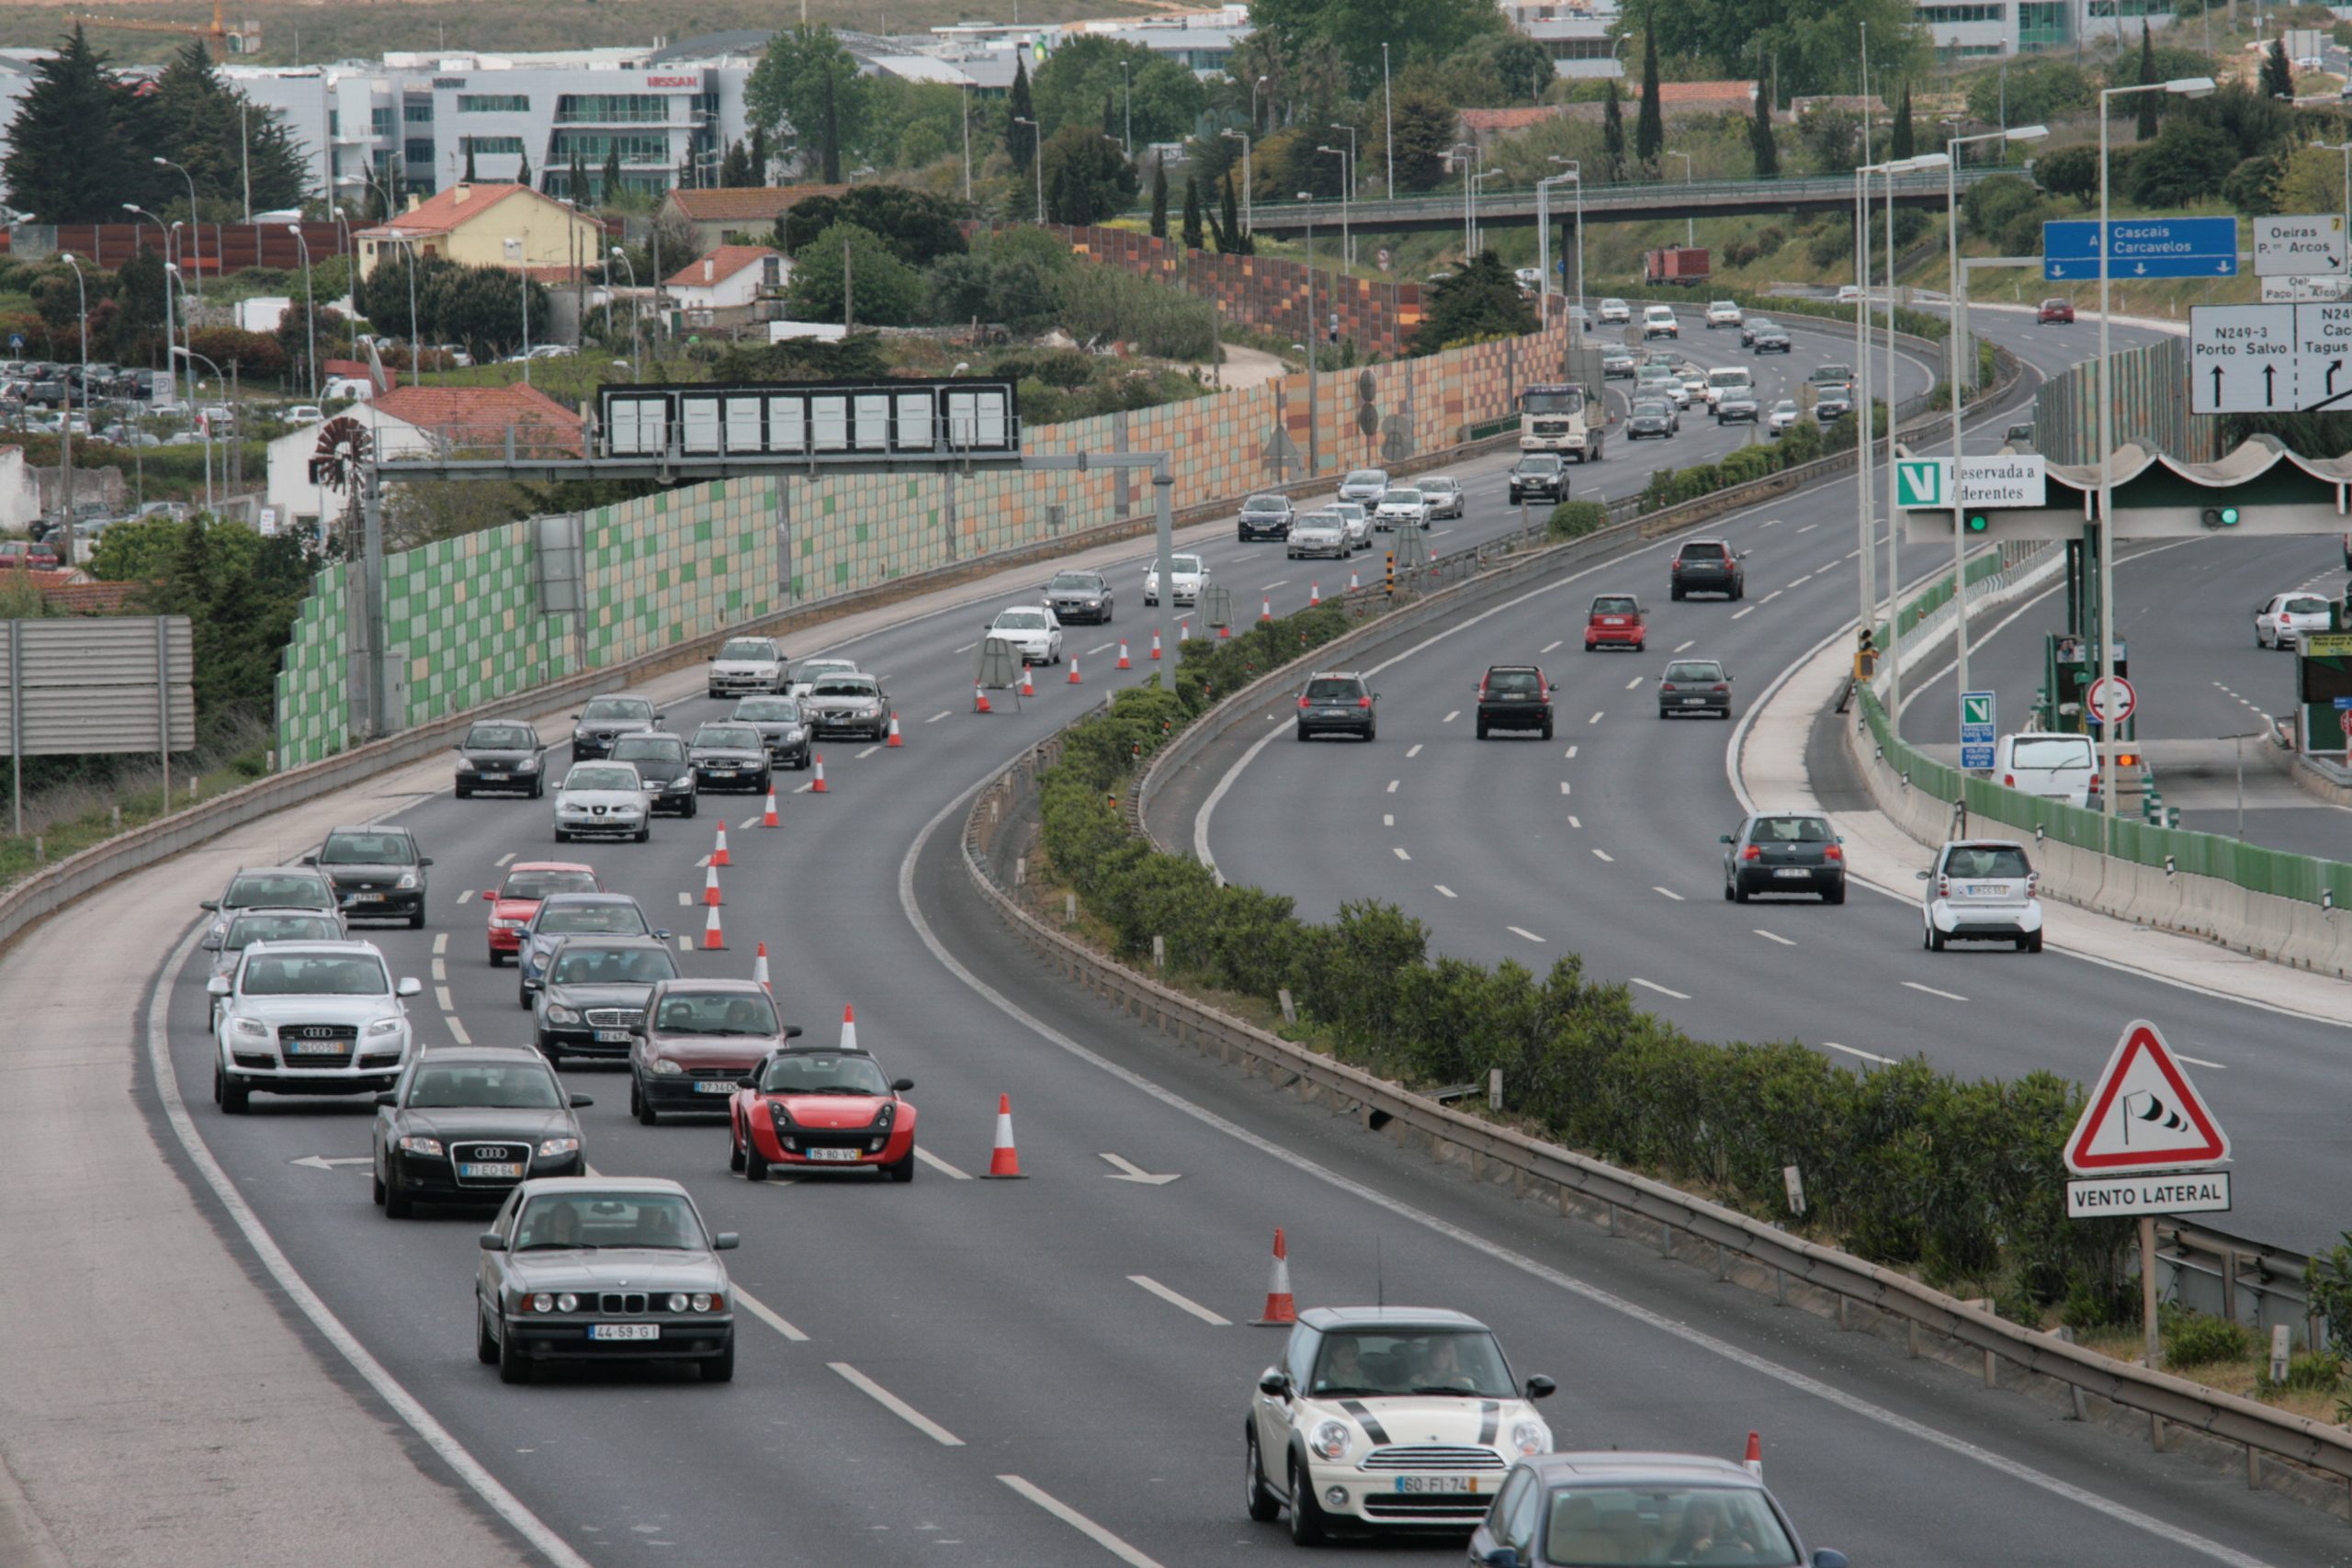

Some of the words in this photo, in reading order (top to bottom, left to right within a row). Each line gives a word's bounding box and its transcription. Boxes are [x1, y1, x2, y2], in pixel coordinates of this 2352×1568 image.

[647, 76, 696, 86] NISSAN
[2333, 219, 2340, 230] 7
[2115, 225, 2169, 238] Cascais
[2271, 227, 2317, 238] Oeiras
[2115, 241, 2191, 253] Carcavelos
[2290, 243, 2330, 253] Arcos
[2215, 327, 2267, 339] N249-3
[2197, 344, 2236, 355] Porto
[2246, 343, 2287, 355] Salvo
[2305, 341, 2348, 355] Tagus
[2028, 468, 2035, 478] a
[2075, 1189, 2135, 1207] VENTO
[2143, 1184, 2221, 1203] LATERAL
